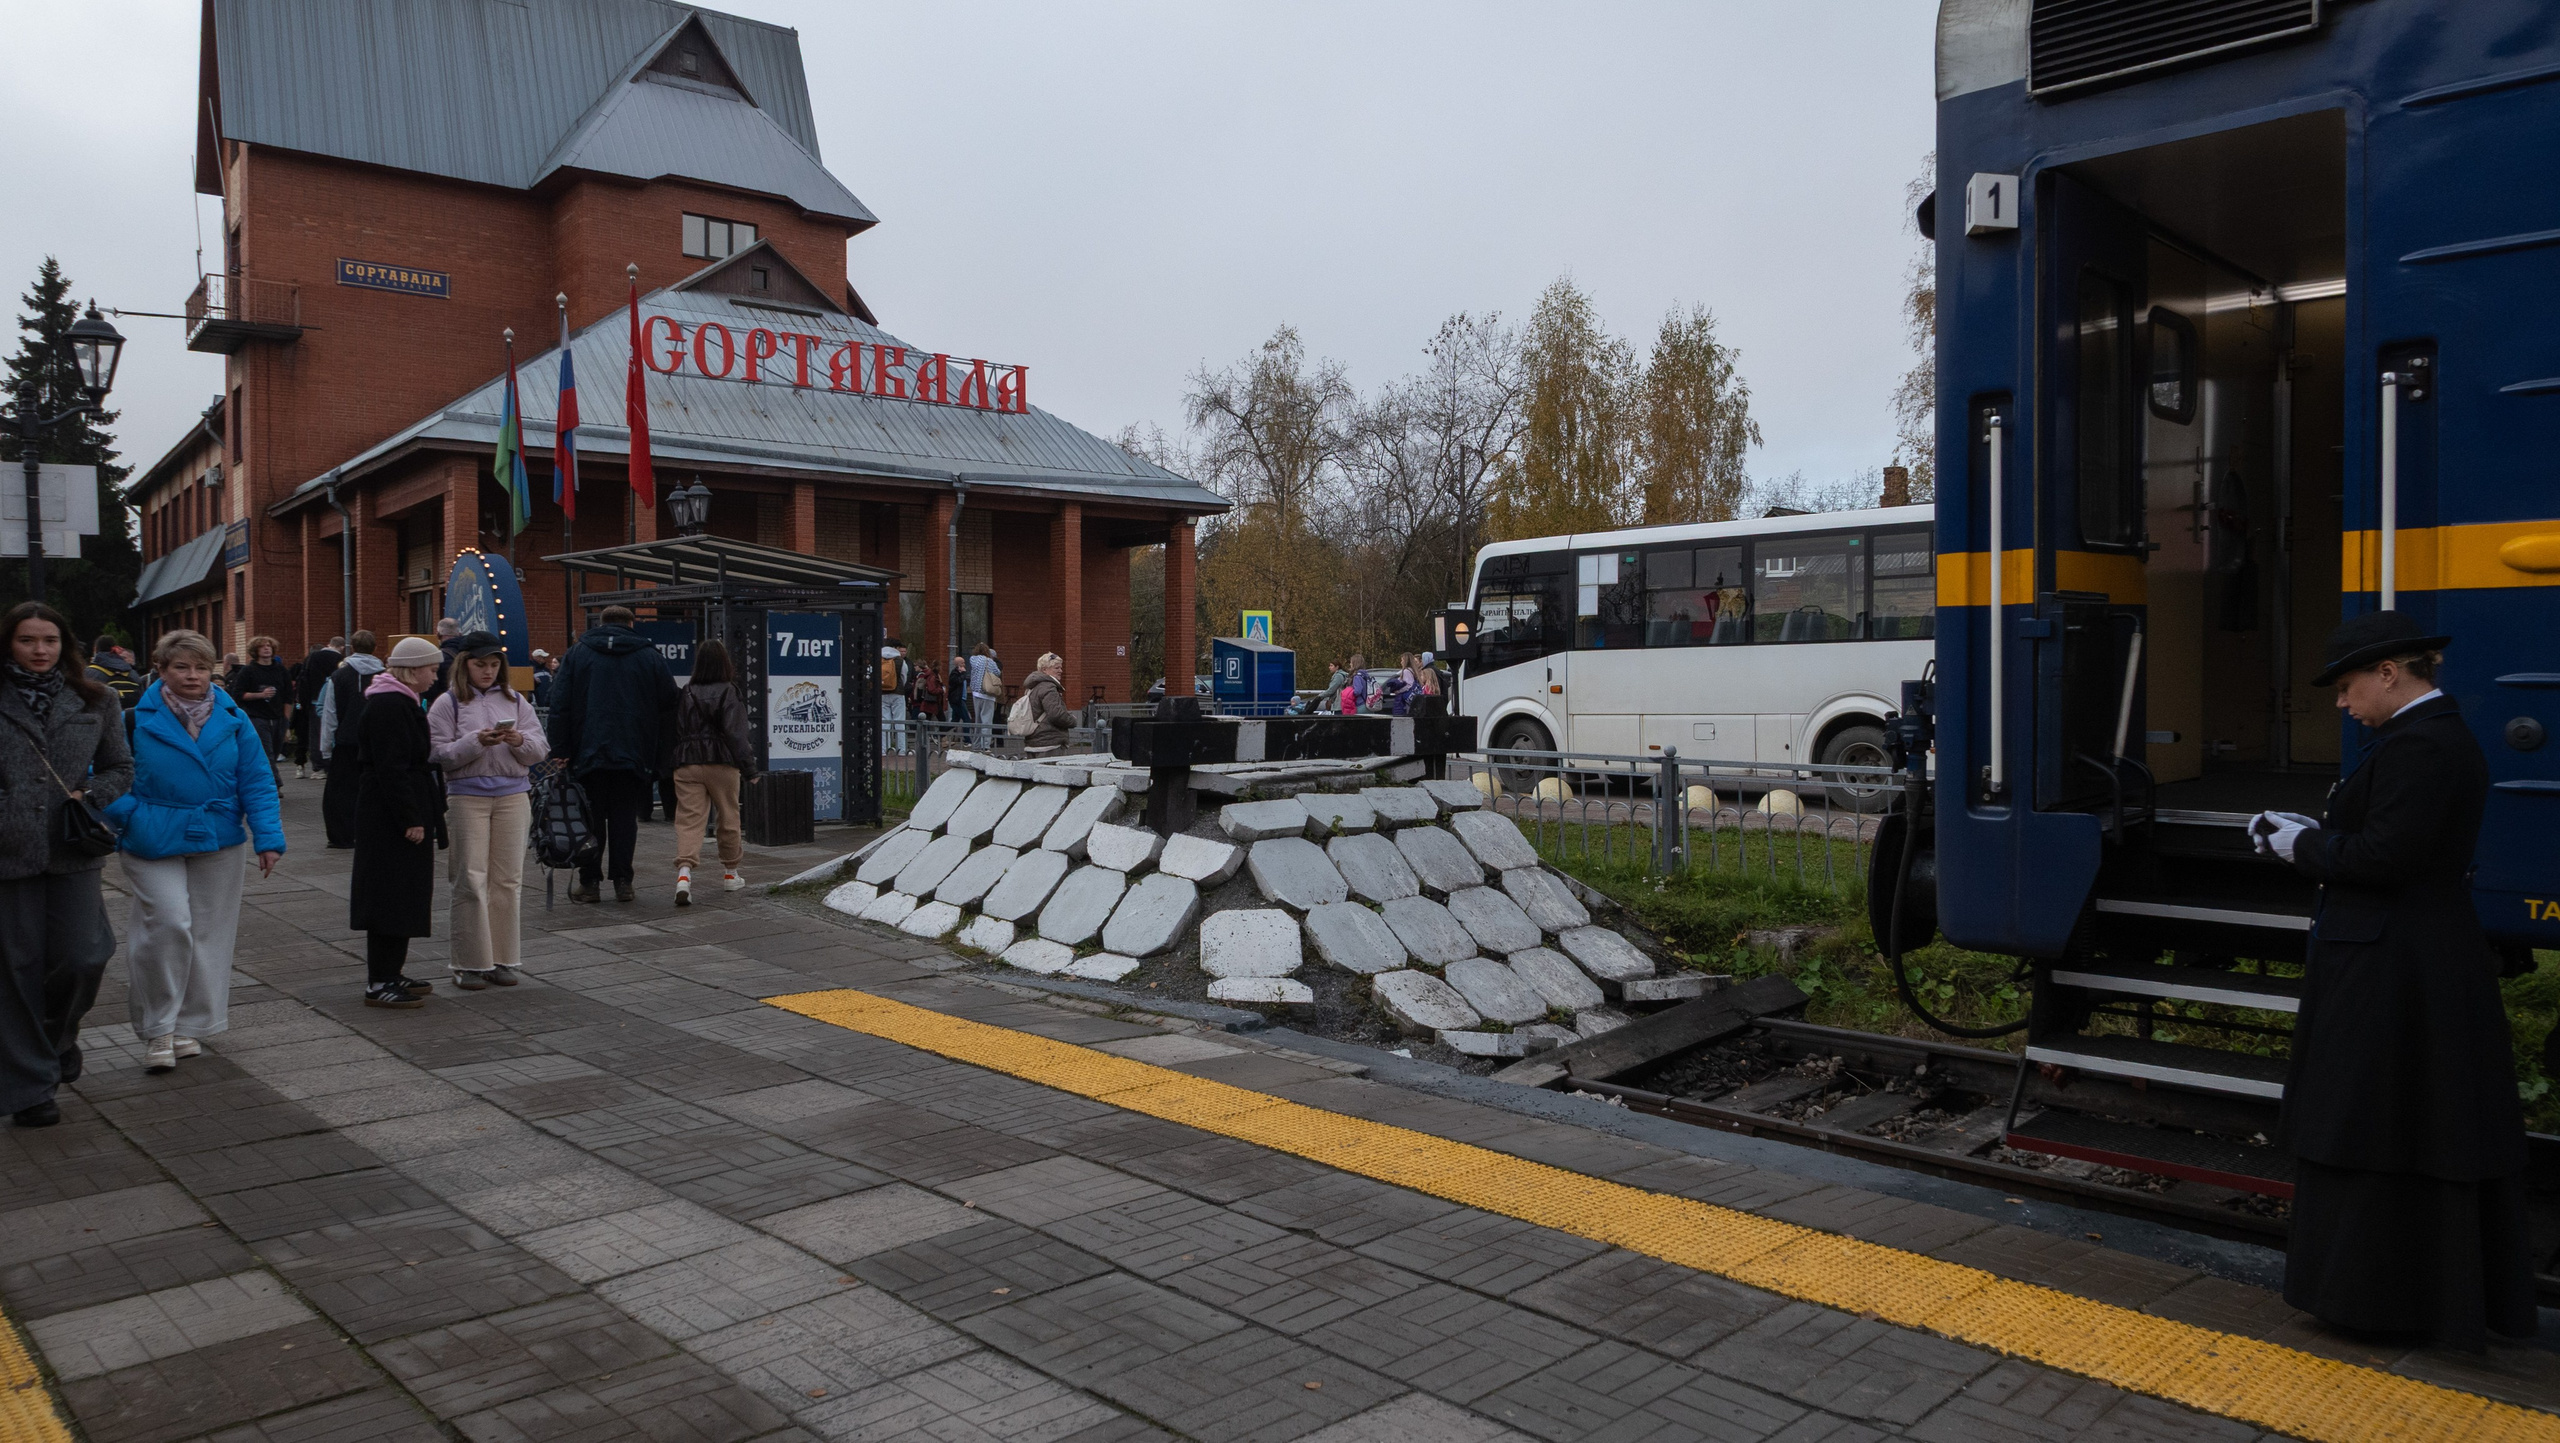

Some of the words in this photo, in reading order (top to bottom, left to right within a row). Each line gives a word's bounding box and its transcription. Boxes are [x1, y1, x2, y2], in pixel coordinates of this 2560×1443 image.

[1988, 182, 2000, 219] 1
[345, 264, 442, 287] СОРТАВАЛА
[641, 315, 1031, 415] СОРТАВАЛА
[655, 643, 689, 660] лет
[776, 632, 794, 657] 7
[797, 638, 834, 658] лет
[1229, 660, 1237, 677] P
[773, 722, 836, 734] РУСКЕАЛЬСКІЙ
[784, 737, 825, 751] ЭКСПРЕССЪ
